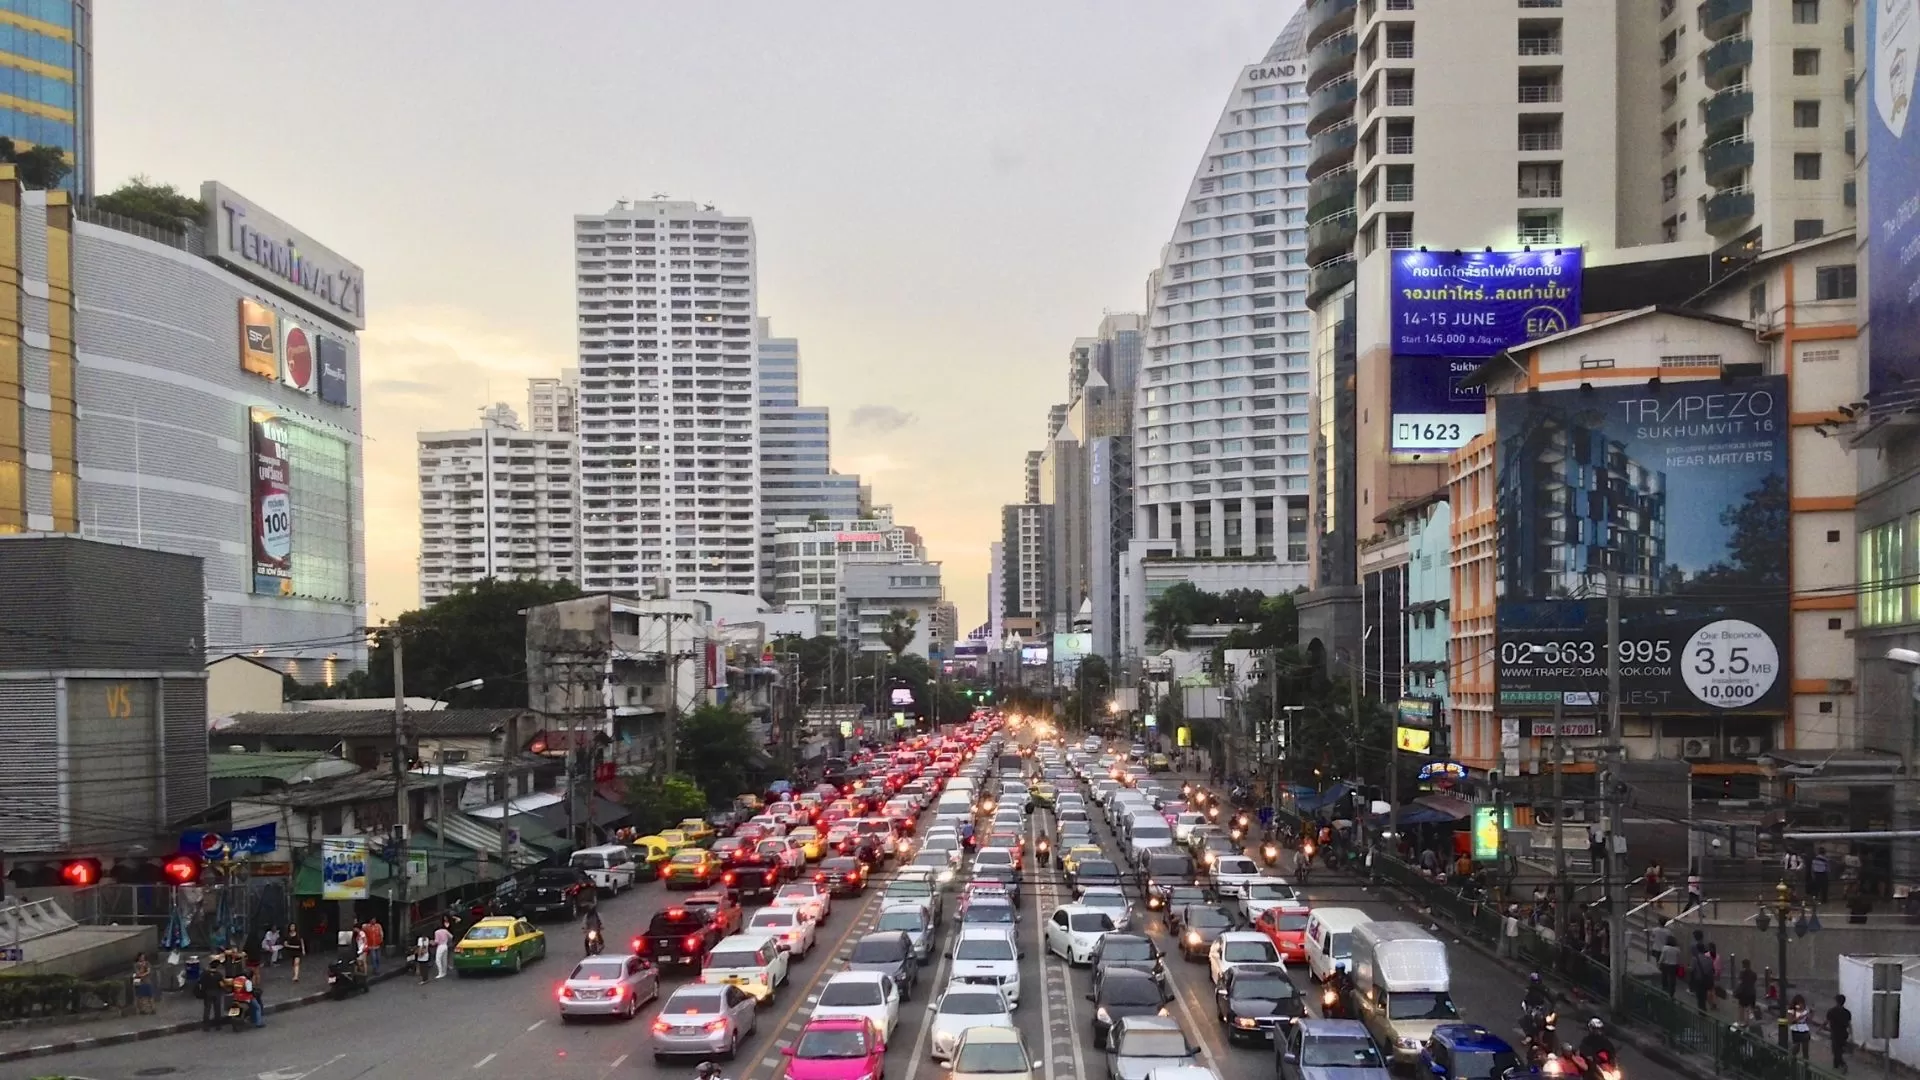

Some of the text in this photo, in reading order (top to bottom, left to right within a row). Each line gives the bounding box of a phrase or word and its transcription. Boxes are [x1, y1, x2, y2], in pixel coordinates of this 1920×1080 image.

[1249, 65, 1295, 80] GRAND
[1403, 312, 1496, 325] 14-15 JUNE
[1526, 318, 1559, 333] EIA
[1401, 336, 1421, 344] Start
[1425, 334, 1466, 345] 145,000
[1617, 390, 1773, 424] TRAPEZO
[1412, 423, 1460, 440] 1623
[1636, 419, 1773, 439] SUKHUMVIT 16
[1665, 450, 1773, 467] NEAR MRT/BTS
[1602, 640, 1672, 663] 995
[1694, 647, 1772, 675] 3.5 MB
[1501, 666, 1672, 678] WWW.TRAPEZOBANKOK.COM
